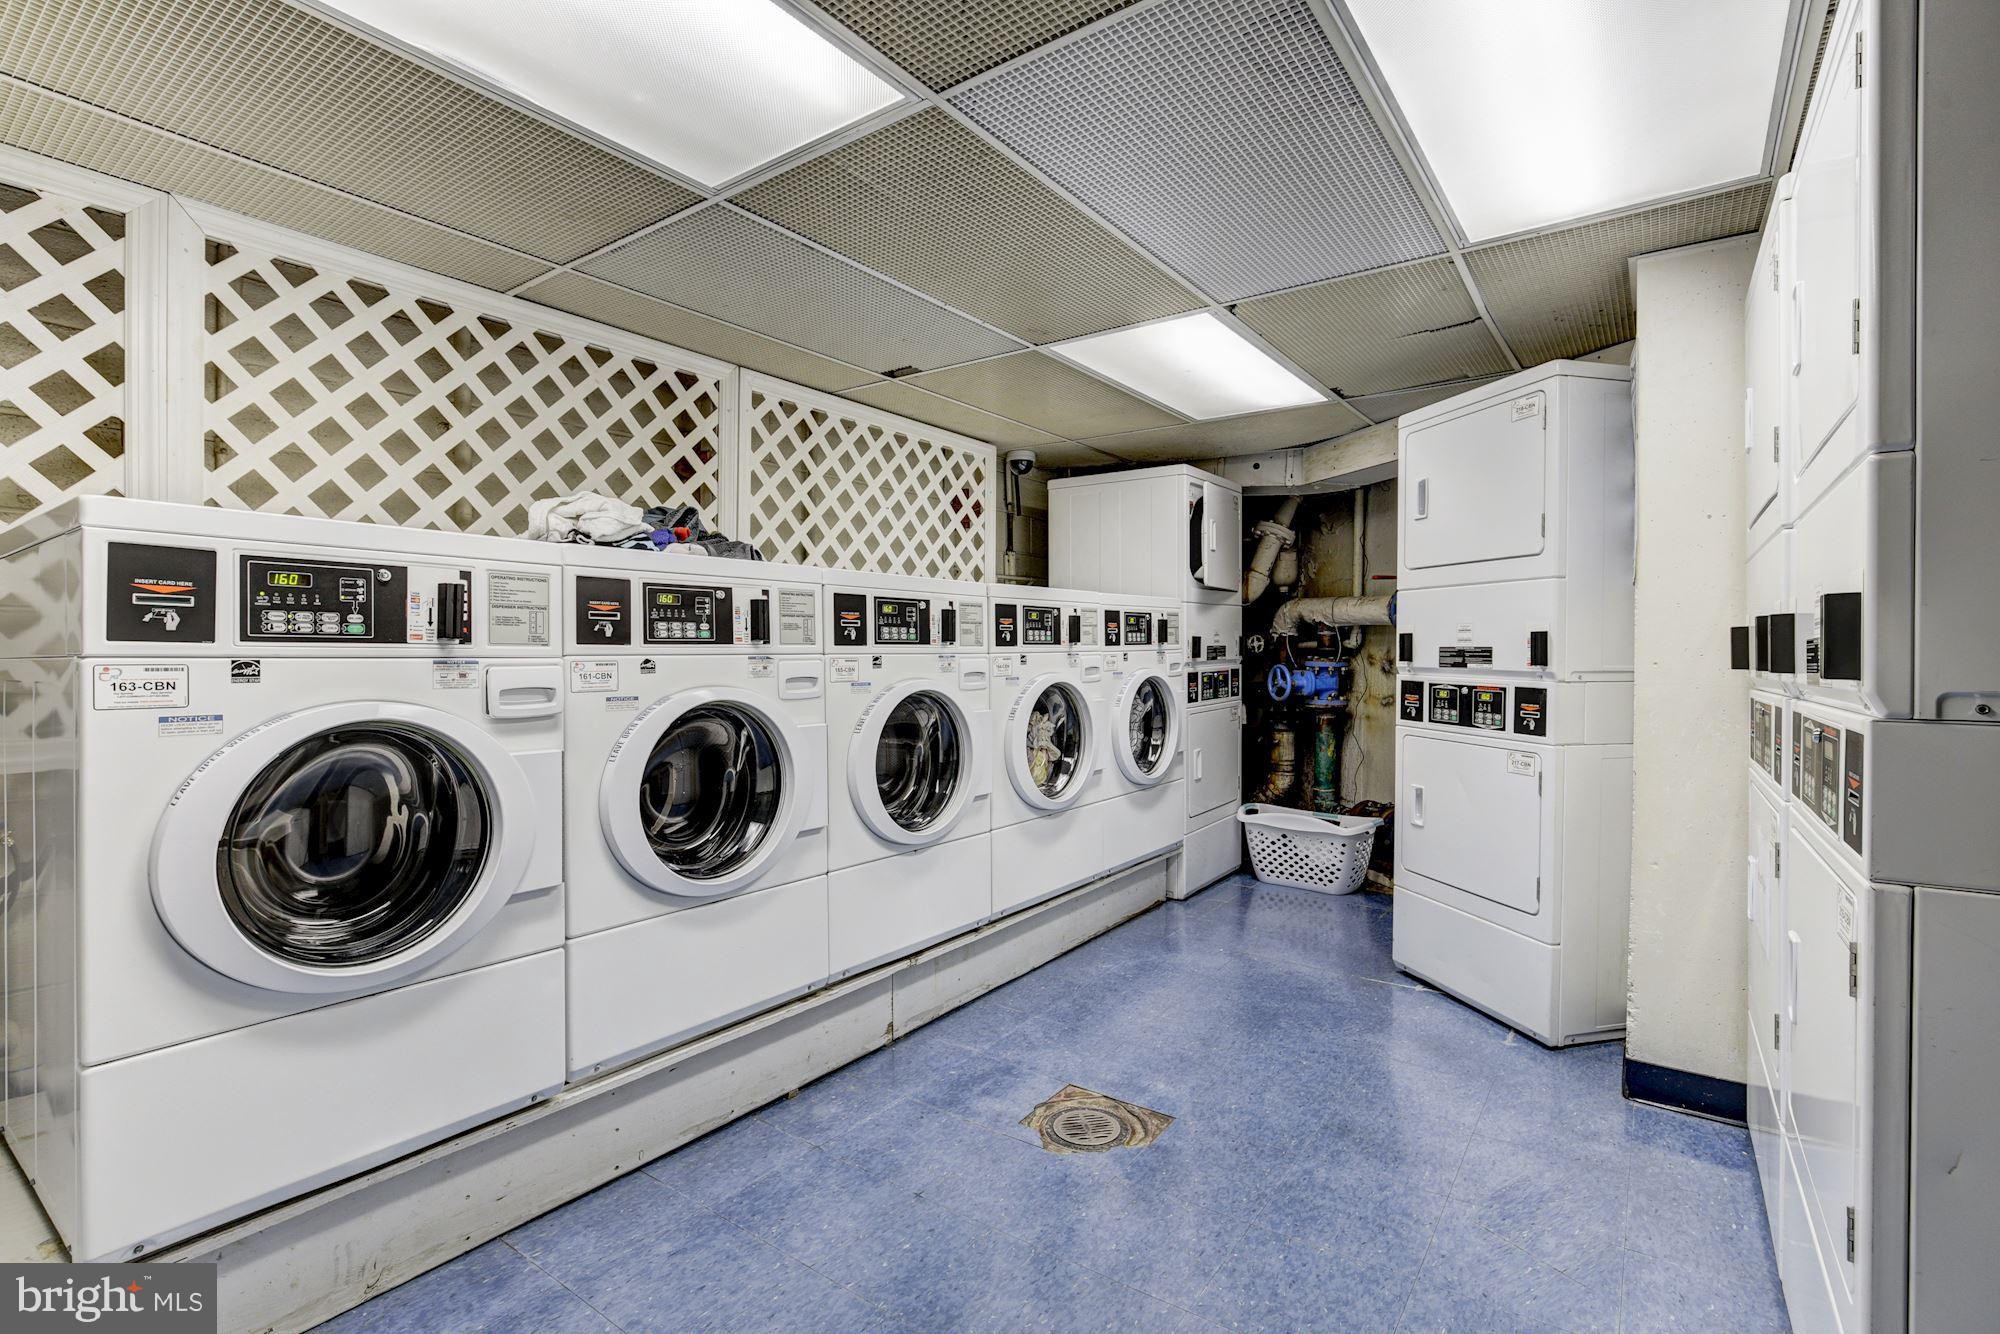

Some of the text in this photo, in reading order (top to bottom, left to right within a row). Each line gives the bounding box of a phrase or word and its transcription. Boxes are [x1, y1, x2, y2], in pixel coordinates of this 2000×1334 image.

[274, 573, 299, 585] 160
[659, 594, 673, 603] 160
[579, 672, 612, 680] 161-CBN
[110, 681, 176, 692] 163-CBN
[168, 715, 215, 723] NOTICE
